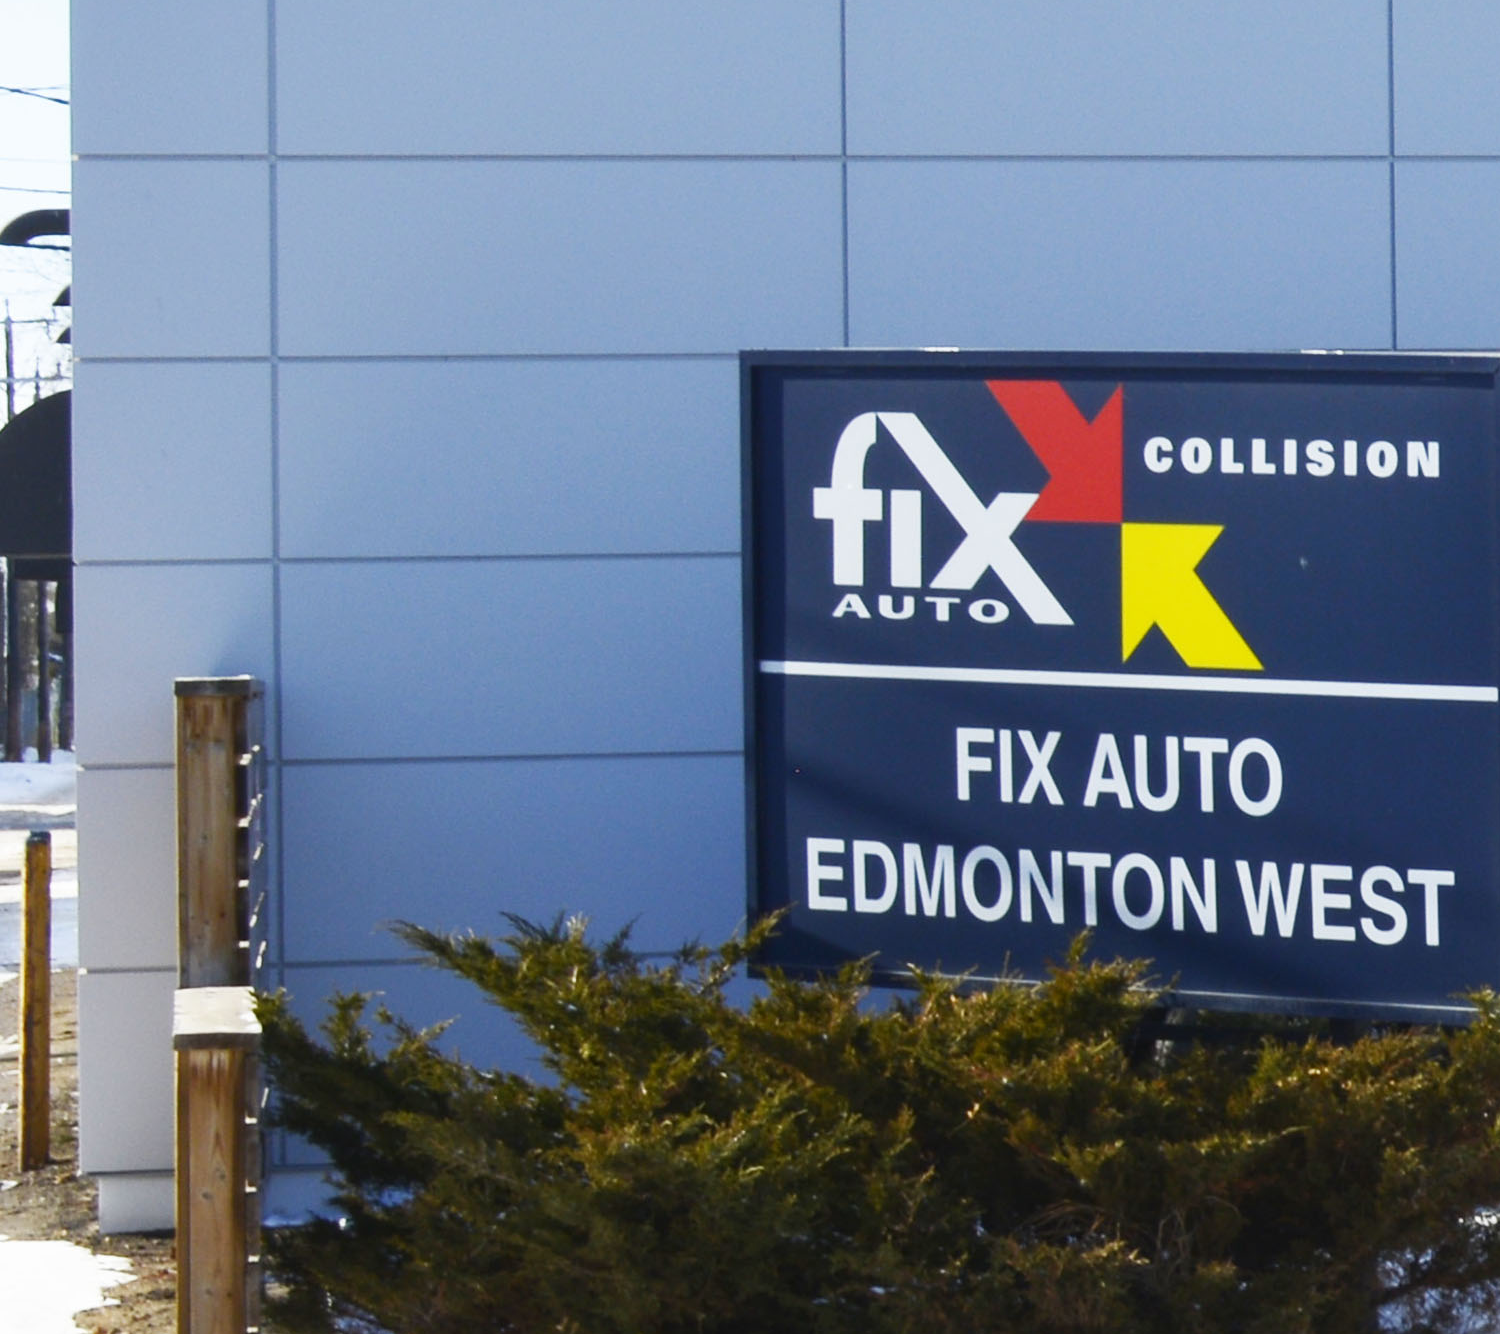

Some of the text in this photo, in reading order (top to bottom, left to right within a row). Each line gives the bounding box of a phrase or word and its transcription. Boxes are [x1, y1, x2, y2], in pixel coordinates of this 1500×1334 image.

[1143, 436, 1440, 478] COLLISION
[813, 411, 1075, 625] fix
[832, 593, 1010, 624] AUTO
[956, 727, 1283, 817] FIX AUTO
[805, 837, 1455, 946] EDMONTON WEST
